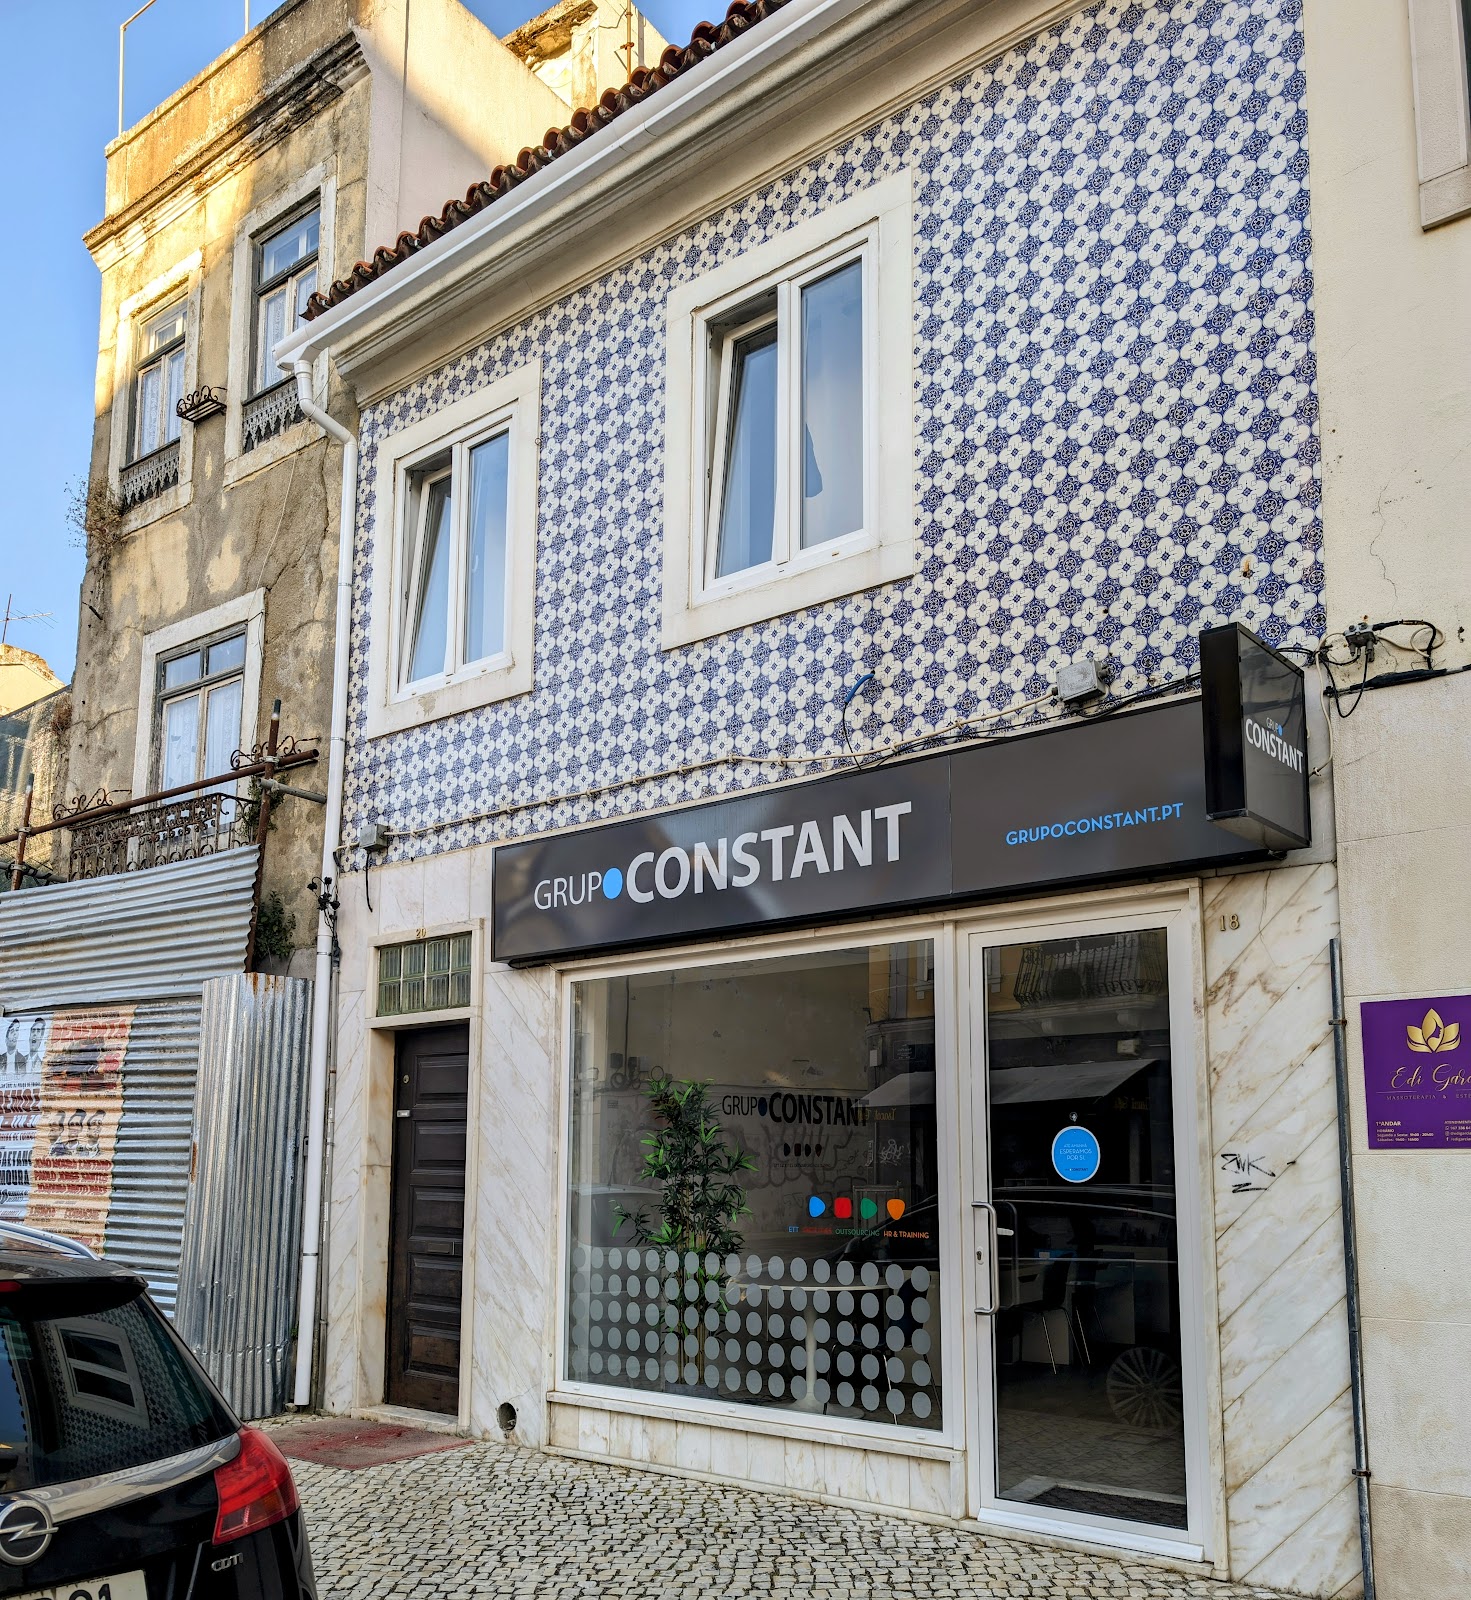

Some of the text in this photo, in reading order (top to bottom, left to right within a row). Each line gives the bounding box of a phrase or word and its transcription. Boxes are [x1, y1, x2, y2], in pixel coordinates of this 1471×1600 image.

[1245, 718, 1304, 774] CONSTANT
[1005, 803, 1184, 845] GRUPOCONSTANT.PT
[626, 801, 912, 904] CONSTANT
[415, 928, 427, 940] 20
[1220, 913, 1240, 931] 18
[1390, 1065, 1425, 1089] Edi
[768, 1092, 870, 1127] CONSTANT
[835, 1228, 881, 1237] OUTSOURCING
[883, 1230, 893, 1238] HR
[899, 1231, 930, 1240] TRAINING
